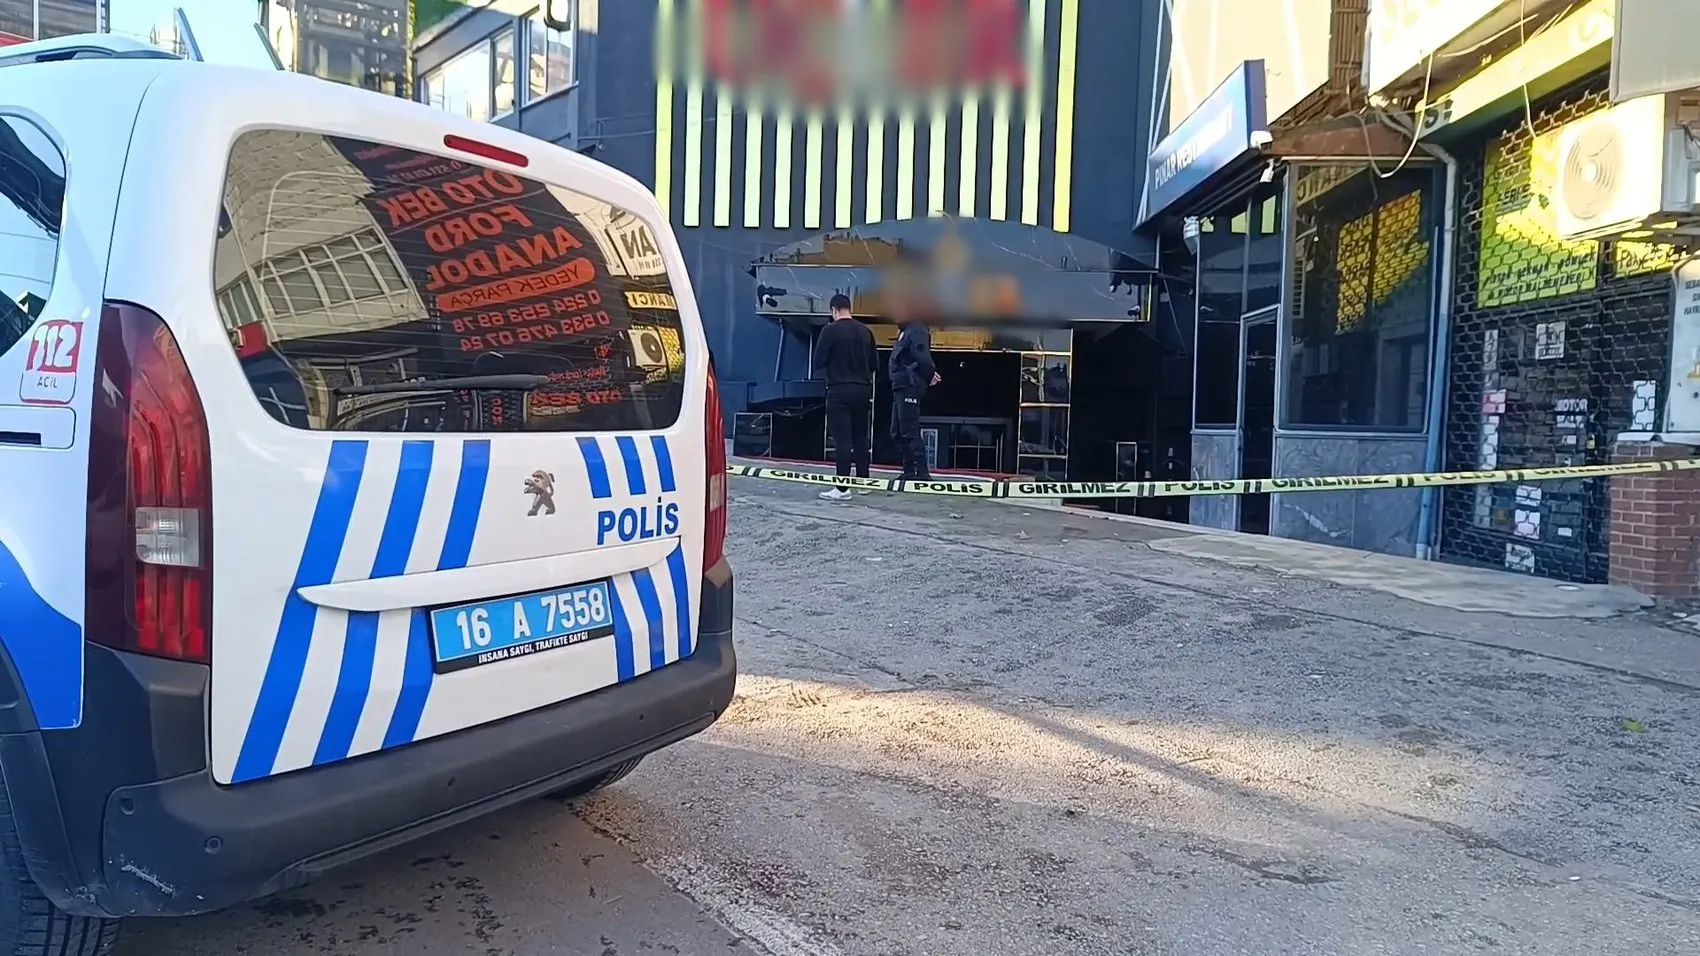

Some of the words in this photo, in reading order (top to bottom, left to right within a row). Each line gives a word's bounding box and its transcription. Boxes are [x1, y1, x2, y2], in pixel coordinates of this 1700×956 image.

[32, 323, 77, 371] 112
[597, 496, 680, 545] POLİS
[456, 607, 491, 650] 16
[512, 601, 531, 639] A
[540, 587, 606, 633] 7558
